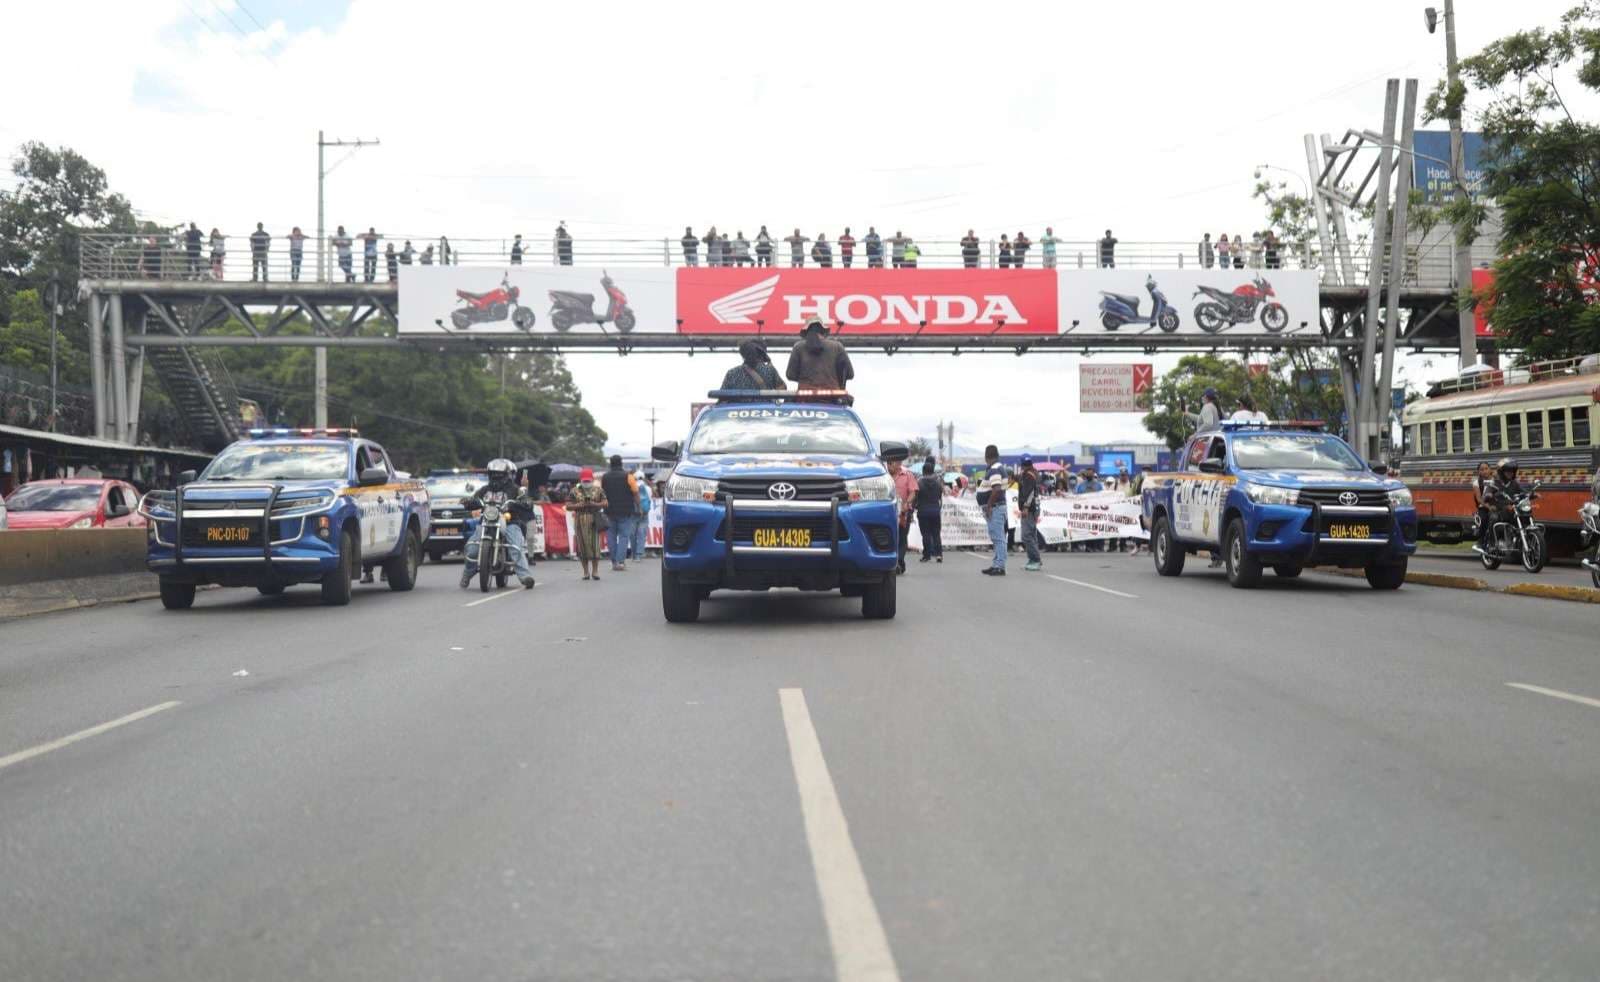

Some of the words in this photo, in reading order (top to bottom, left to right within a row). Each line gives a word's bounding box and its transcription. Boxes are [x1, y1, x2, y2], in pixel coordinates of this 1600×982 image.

[783, 294, 1027, 325] HONDA
[1091, 378, 1120, 386] CARRIL
[1081, 388, 1131, 397] REVERSIBLE
[1172, 479, 1222, 506] POLICIA
[1069, 512, 1107, 522] DEPARTAMENTO
[207, 527, 250, 541] PNC-DT-107
[754, 528, 811, 547] GUA-14305
[1330, 524, 1370, 539] GUA-14203
